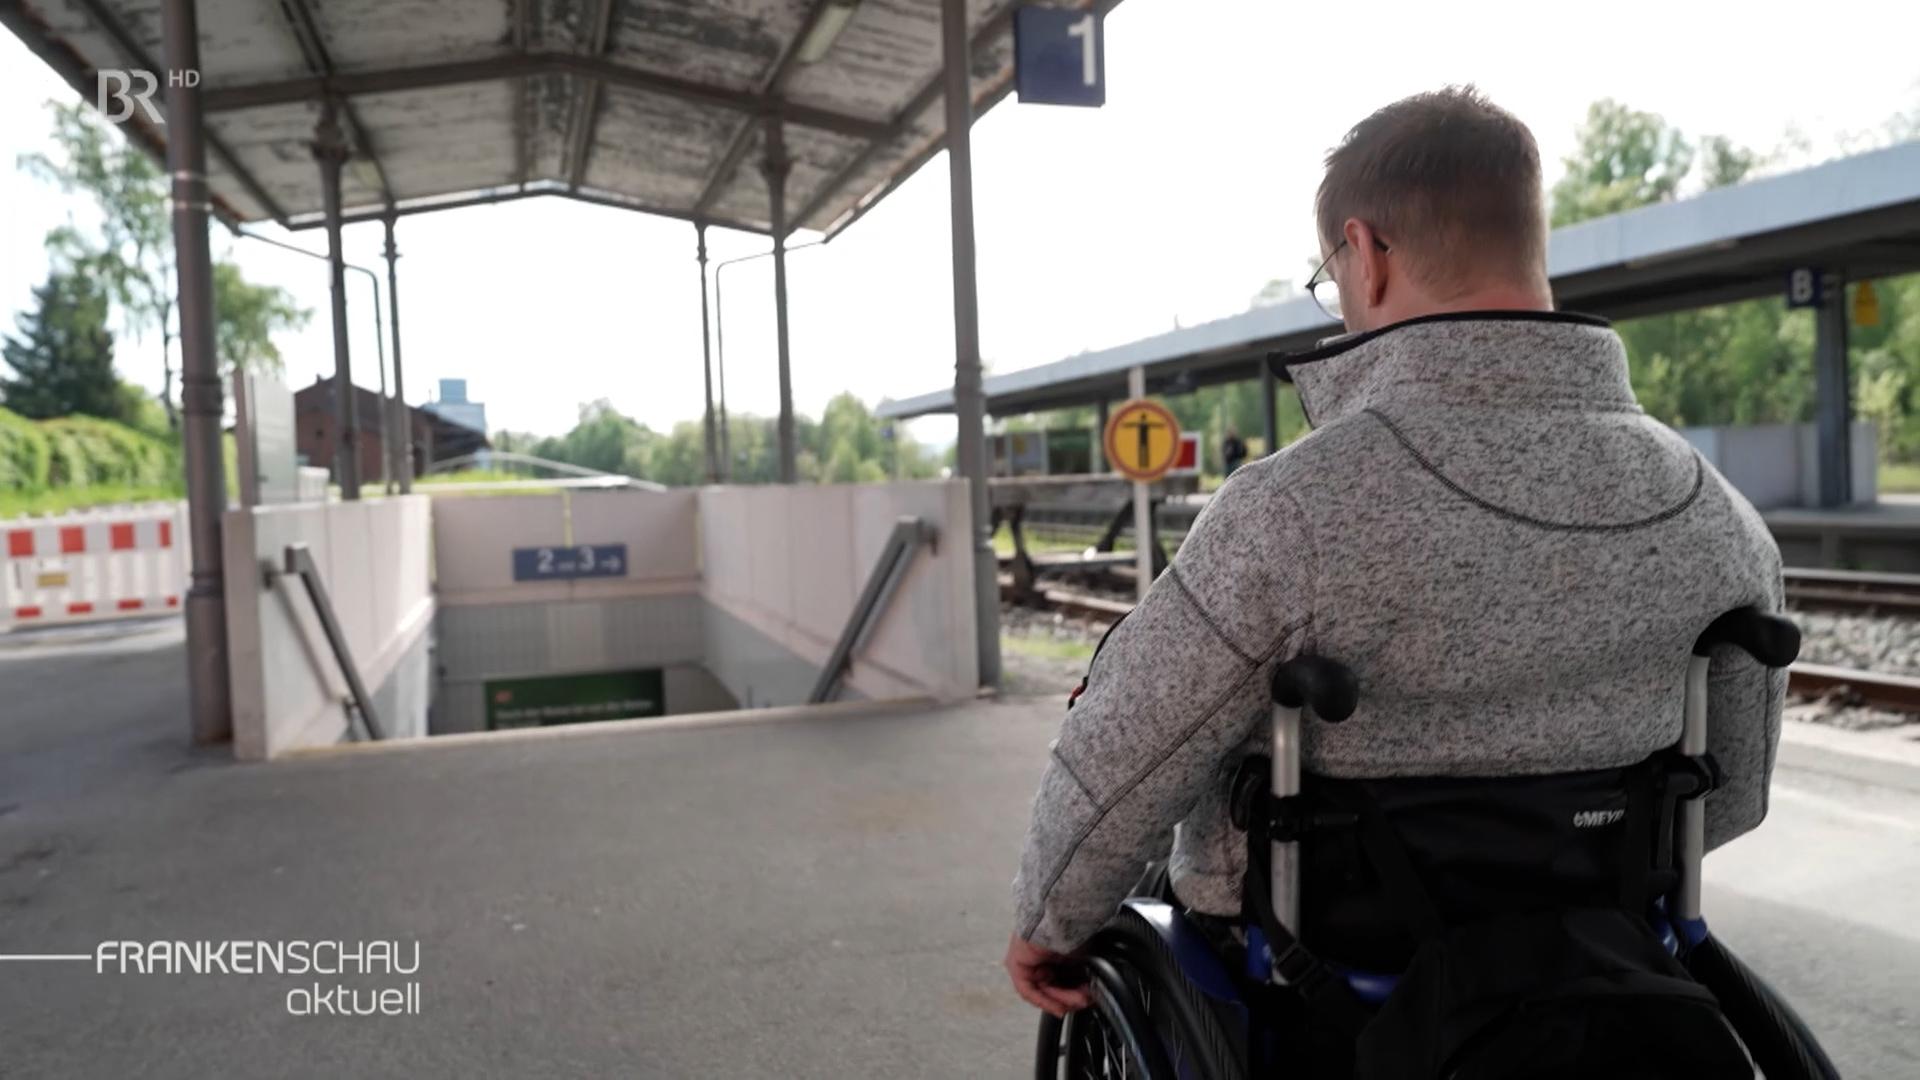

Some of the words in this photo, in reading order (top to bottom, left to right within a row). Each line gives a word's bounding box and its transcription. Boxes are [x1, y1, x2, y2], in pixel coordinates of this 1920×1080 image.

[1067, 13, 1096, 86] 1
[537, 548, 554, 573] 2
[578, 545, 596, 572] 3
